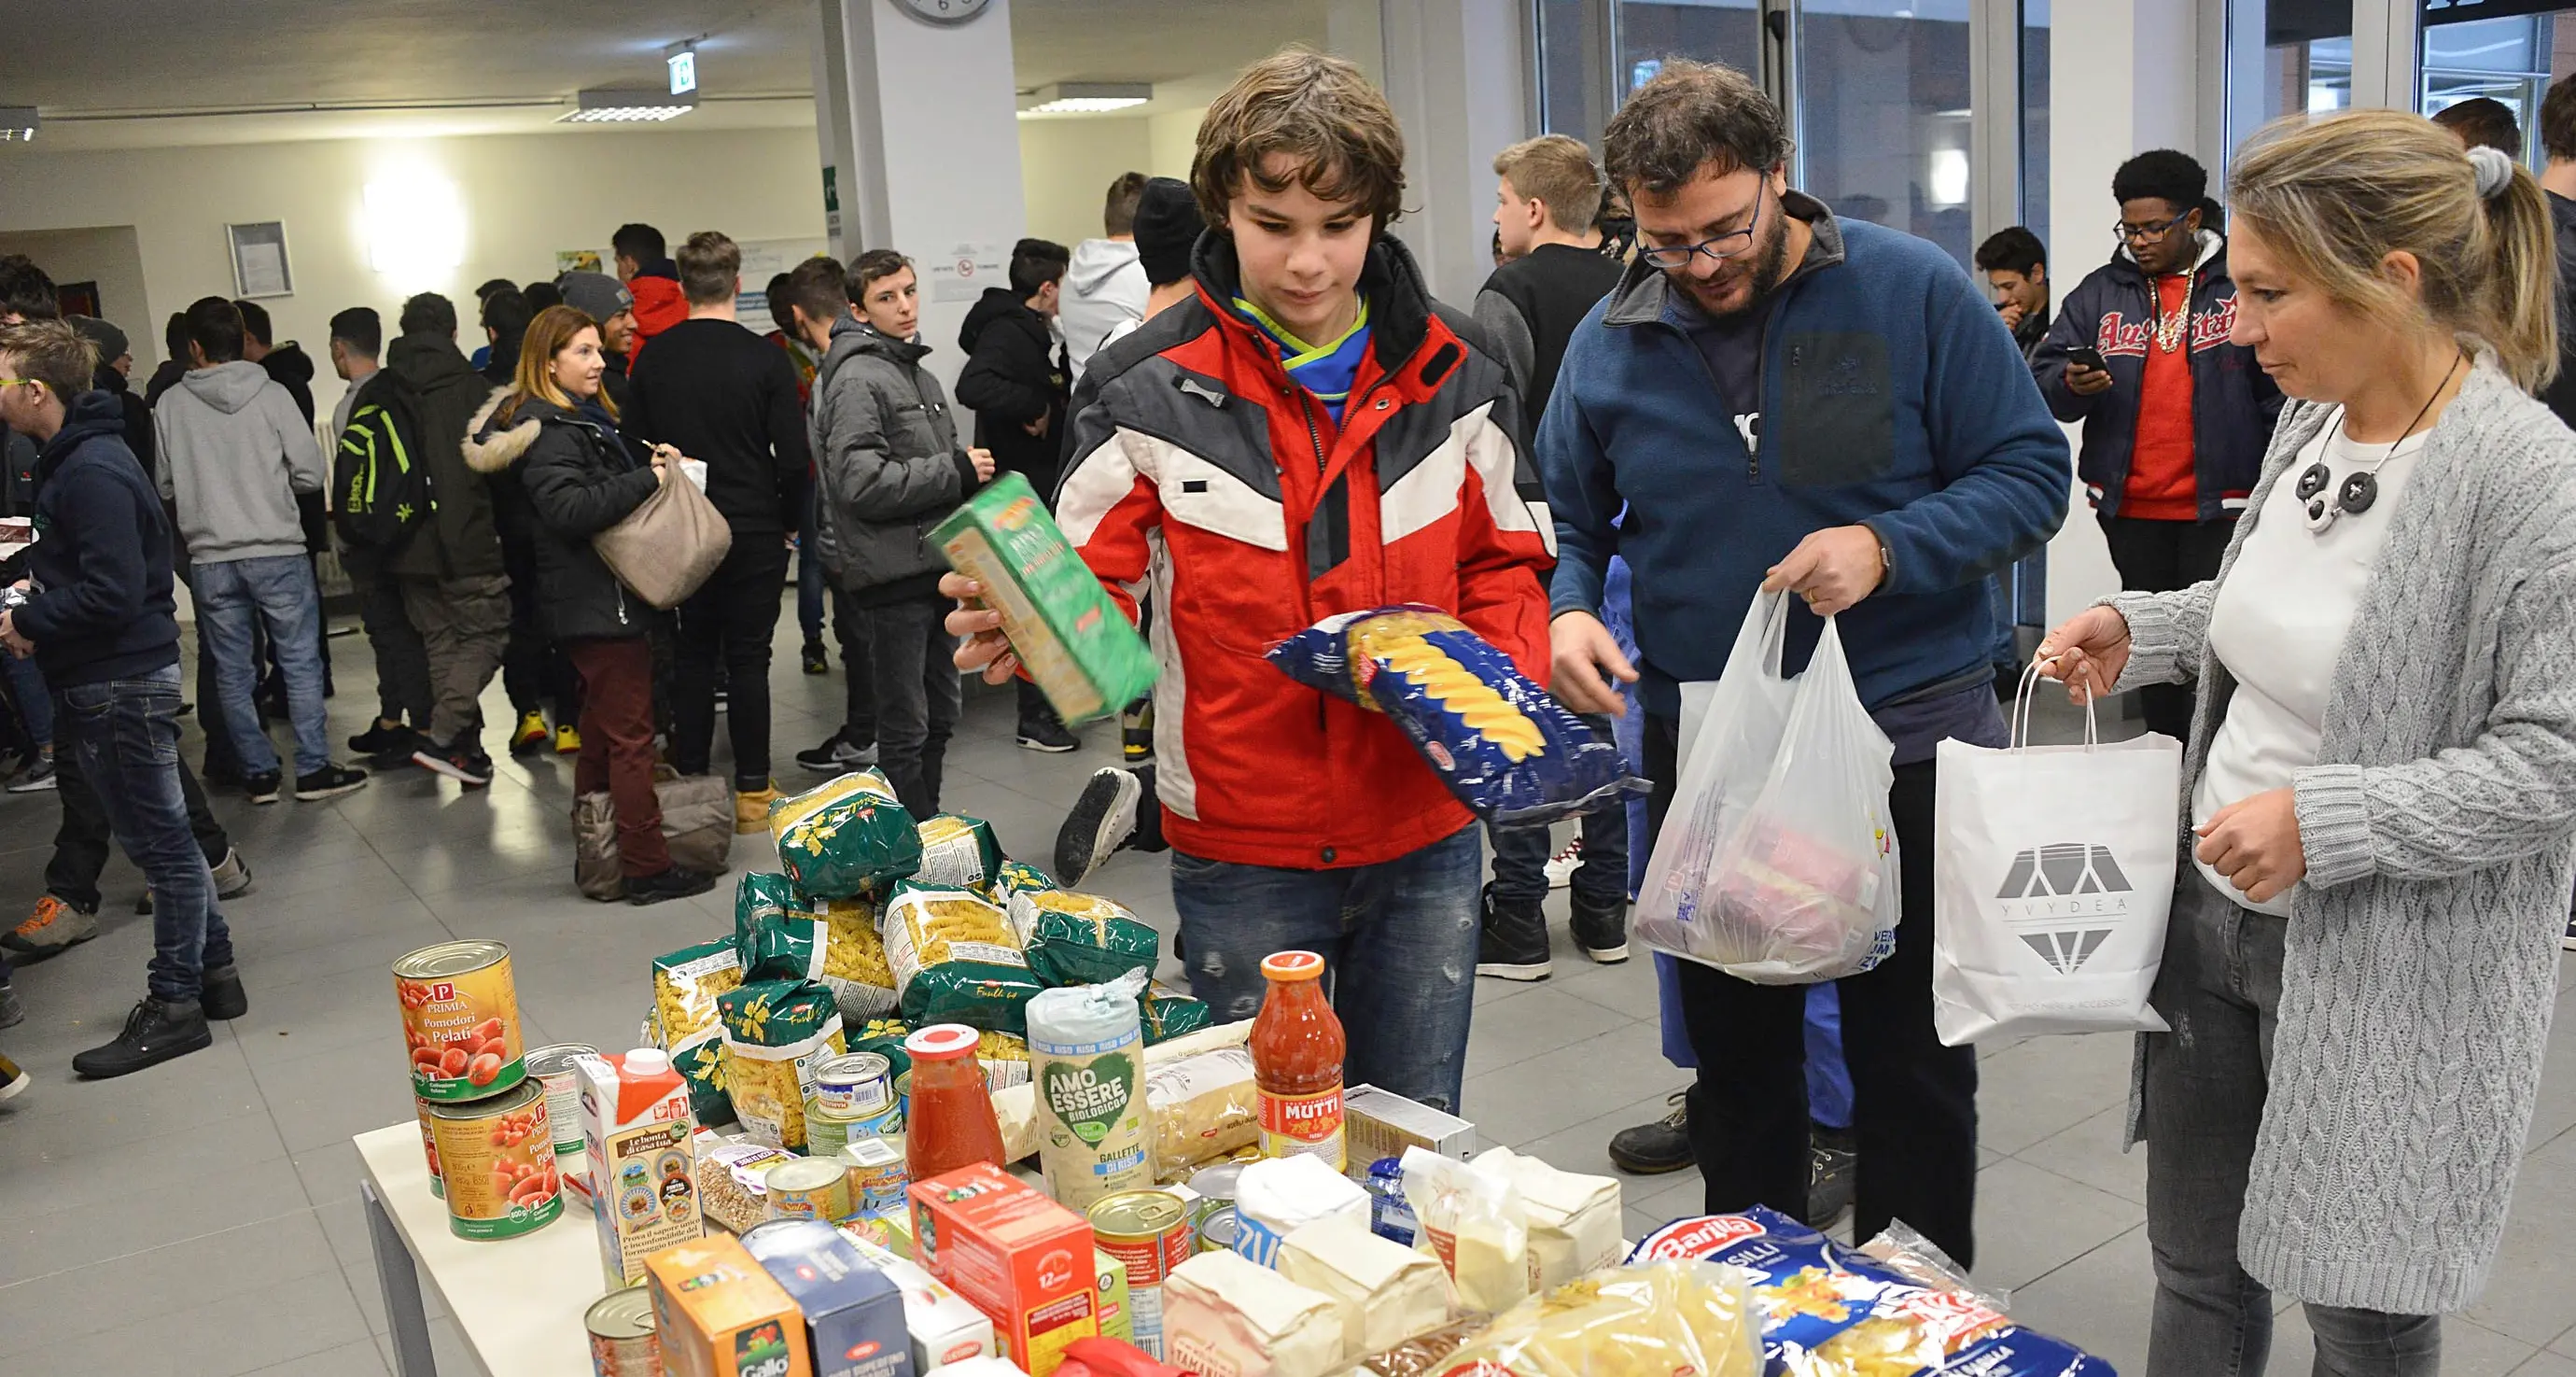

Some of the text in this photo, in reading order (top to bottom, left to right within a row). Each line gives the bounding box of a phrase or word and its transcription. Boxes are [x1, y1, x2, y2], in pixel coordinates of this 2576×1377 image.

[2001, 899, 2127, 917] YVYDEA
[427, 1001, 469, 1014] PRIMIA
[424, 1012, 476, 1028] Pomodori
[432, 1027, 471, 1043] Pelati
[1054, 1046, 1073, 1055] RISO
[1076, 1044, 1096, 1054] RISO
[1050, 1069, 1097, 1094] AMO
[1051, 1076, 1125, 1113] ESSERE
[1069, 1100, 1120, 1122] BIOLOGICO
[1285, 1096, 1337, 1119] MUTTI
[636, 1142, 655, 1152] casa
[1099, 1143, 1140, 1163] GALLETTE
[623, 1233, 646, 1244] Prova
[653, 1225, 679, 1236] sapore
[630, 1229, 685, 1249] inconfondibile
[1649, 1218, 1755, 1261] Barilla
[624, 1243, 667, 1258] formaggio
[1727, 1243, 1781, 1267] SILLI
